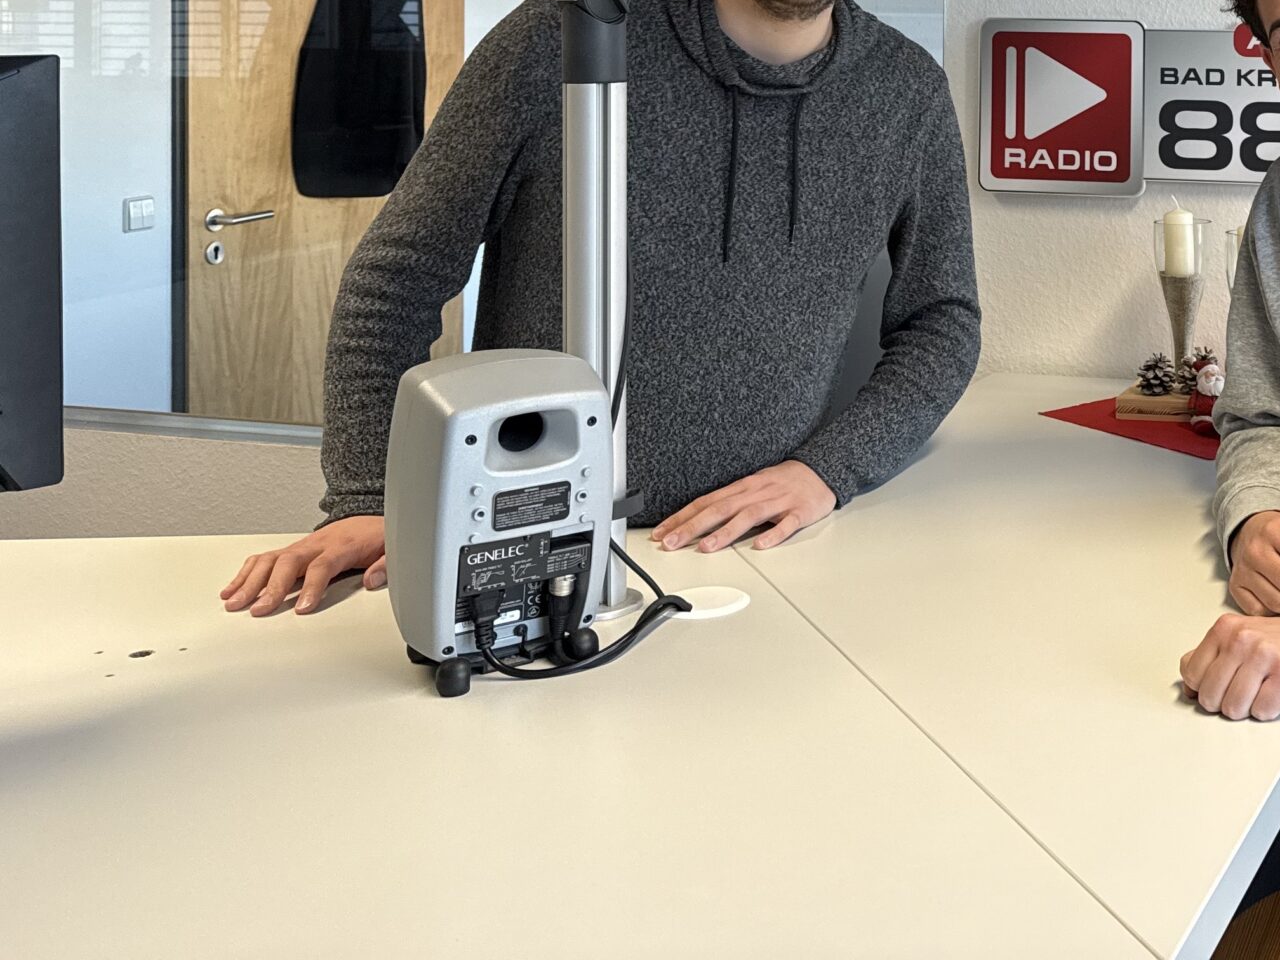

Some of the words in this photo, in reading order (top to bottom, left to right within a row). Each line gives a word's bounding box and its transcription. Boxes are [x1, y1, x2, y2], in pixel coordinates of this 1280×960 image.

[1160, 67, 1225, 87] BAD
[1004, 147, 1118, 172] RADIO
[467, 544, 524, 565] GENELEC
